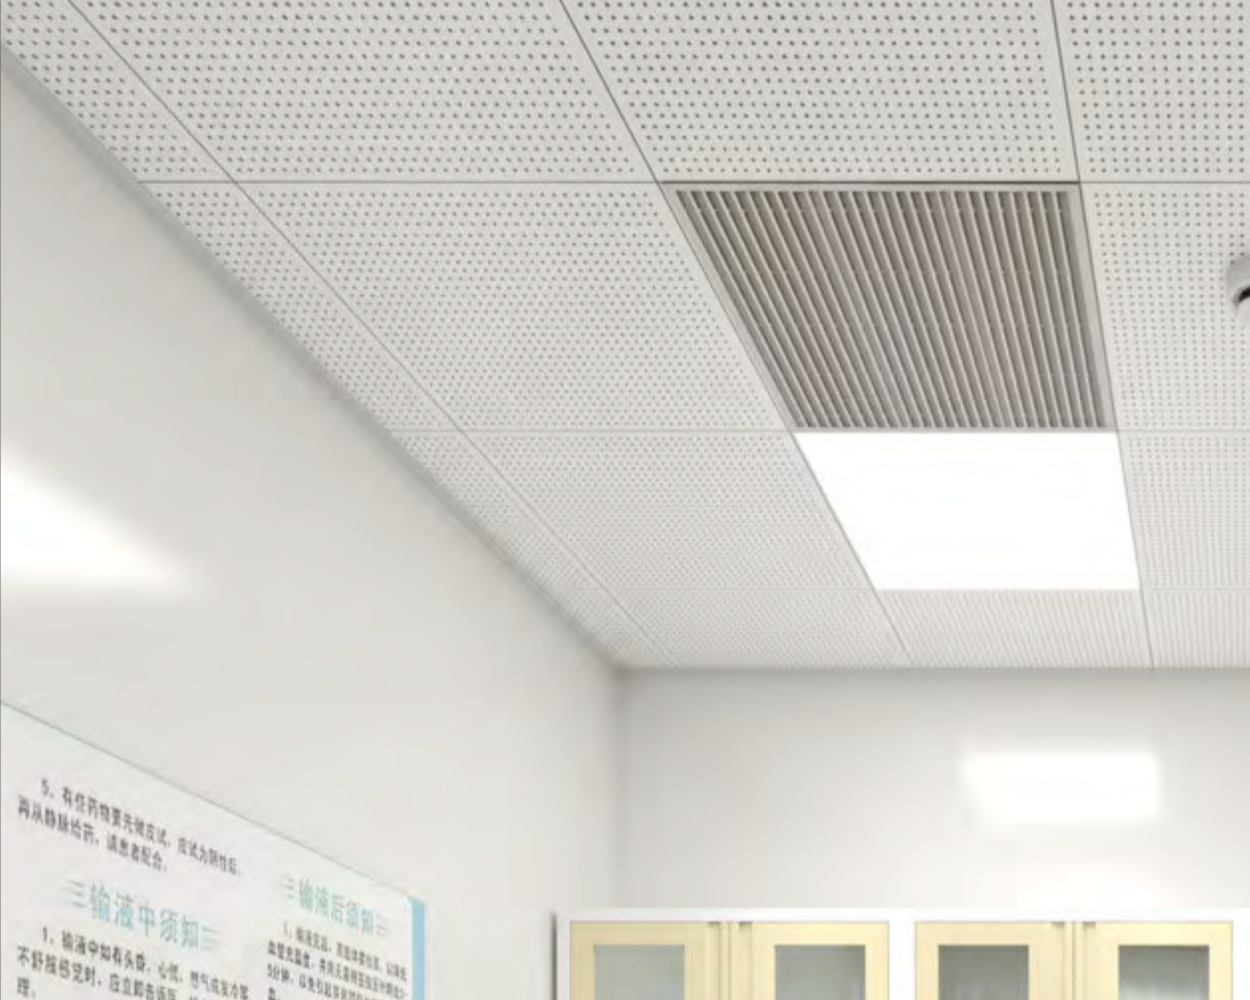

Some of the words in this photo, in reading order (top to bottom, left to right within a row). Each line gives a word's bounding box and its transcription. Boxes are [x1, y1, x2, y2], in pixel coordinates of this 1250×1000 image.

[89, 880, 198, 948] 输液中须知
